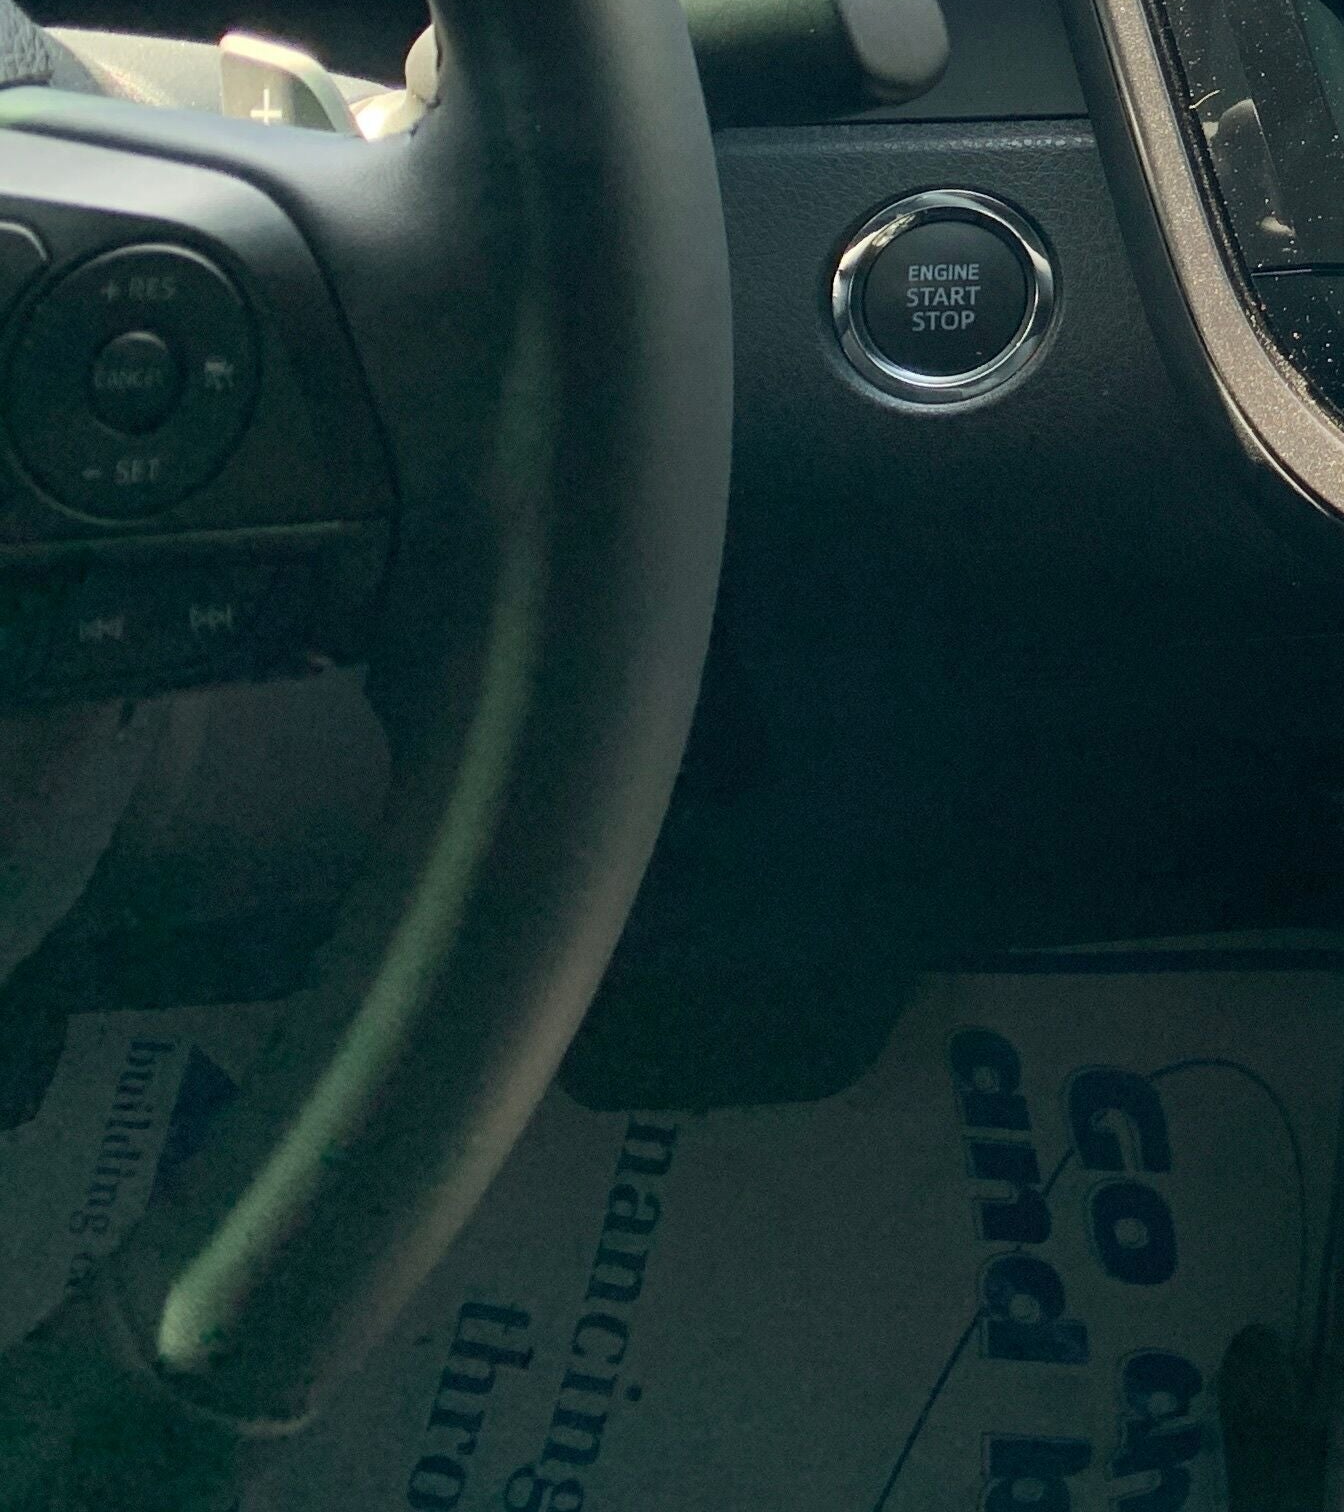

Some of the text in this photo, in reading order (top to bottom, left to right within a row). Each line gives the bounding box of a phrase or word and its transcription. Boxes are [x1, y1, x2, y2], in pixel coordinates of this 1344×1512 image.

[905, 286, 981, 308] START
[907, 263, 980, 282] ENGINE
[911, 310, 976, 332] STOP
[68, 1040, 175, 1236] building
[1066, 1068, 1178, 1286] Go
[948, 1028, 1091, 1366] and
